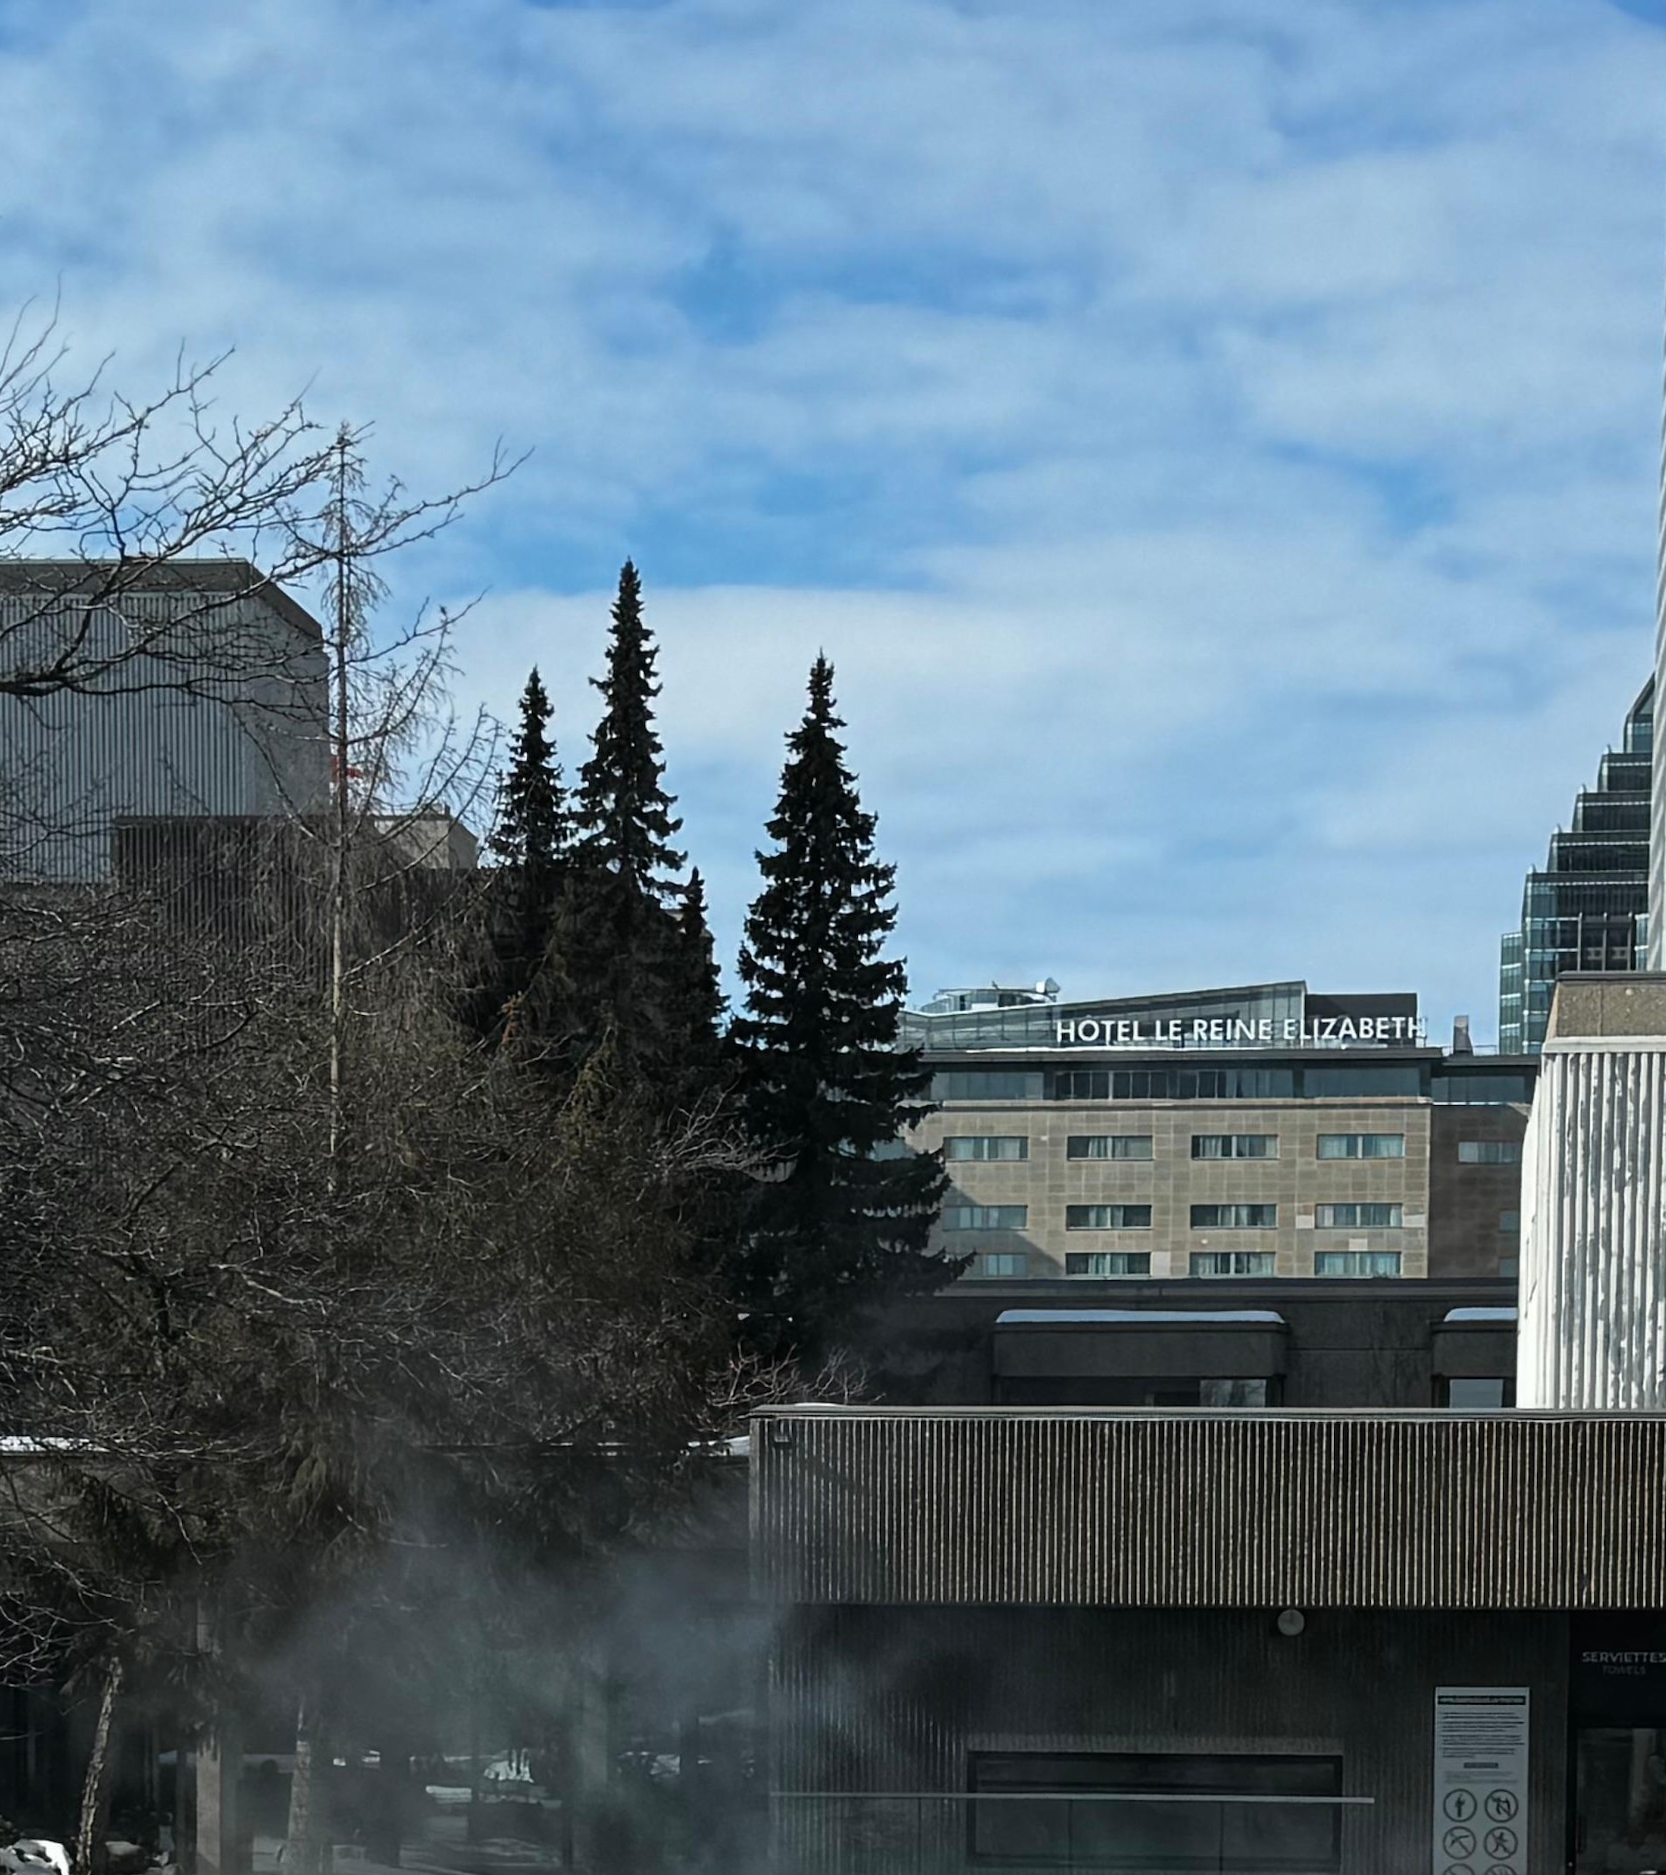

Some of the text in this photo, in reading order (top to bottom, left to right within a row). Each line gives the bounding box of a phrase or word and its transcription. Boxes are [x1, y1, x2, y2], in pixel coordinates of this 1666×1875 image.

[1056, 1014, 1426, 1042] HÔTEL LE REINE ELIZABETH
[1601, 1665, 1647, 1675] TOWELS
